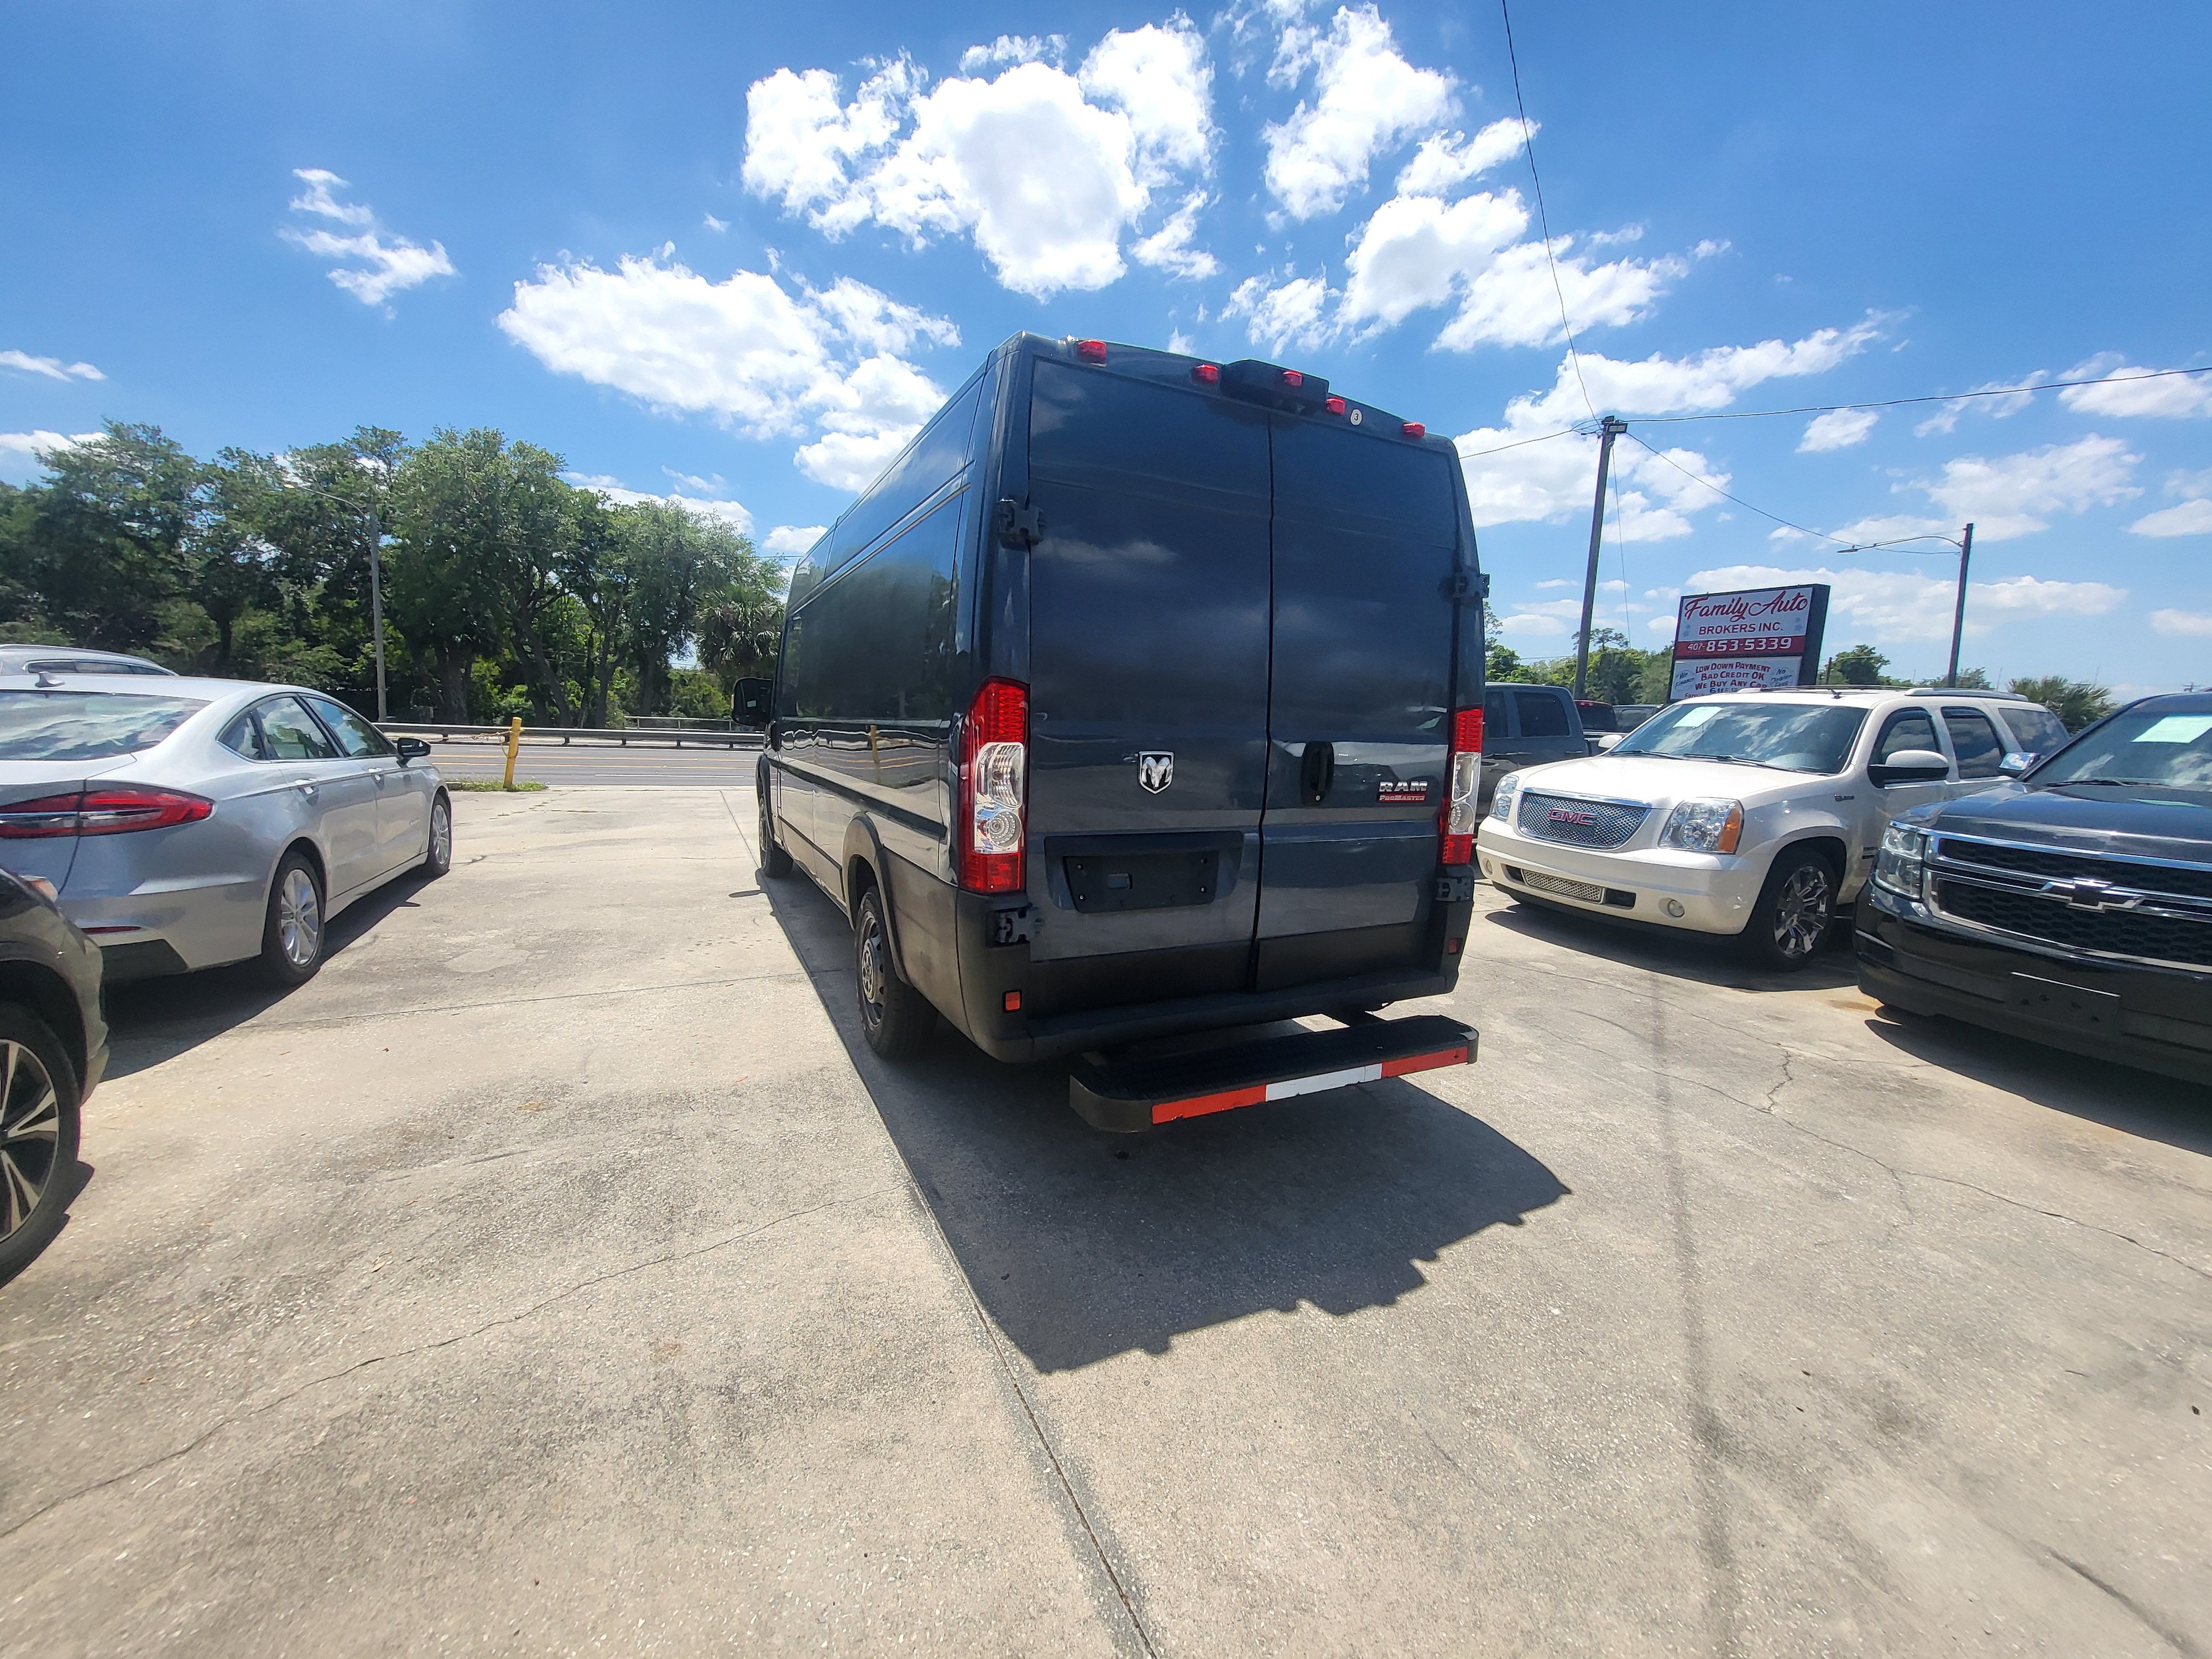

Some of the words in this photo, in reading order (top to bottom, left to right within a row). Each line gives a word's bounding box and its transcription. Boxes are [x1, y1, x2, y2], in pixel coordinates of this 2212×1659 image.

[1684, 596, 1749, 622] Family
[1748, 590, 1808, 617] Auto
[1699, 623, 1756, 635] BROKERS
[1759, 622, 1783, 632] INC.
[1695, 665, 1710, 674] LOW
[1735, 662, 1771, 673] PAYMENT
[1701, 672, 1719, 681] BAD
[1720, 670, 1749, 679] CREDIT
[1751, 671, 1765, 681] OK
[1695, 682, 1708, 690] WE
[1379, 781, 1428, 792] RAM
[1548, 808, 1598, 825] GMC
